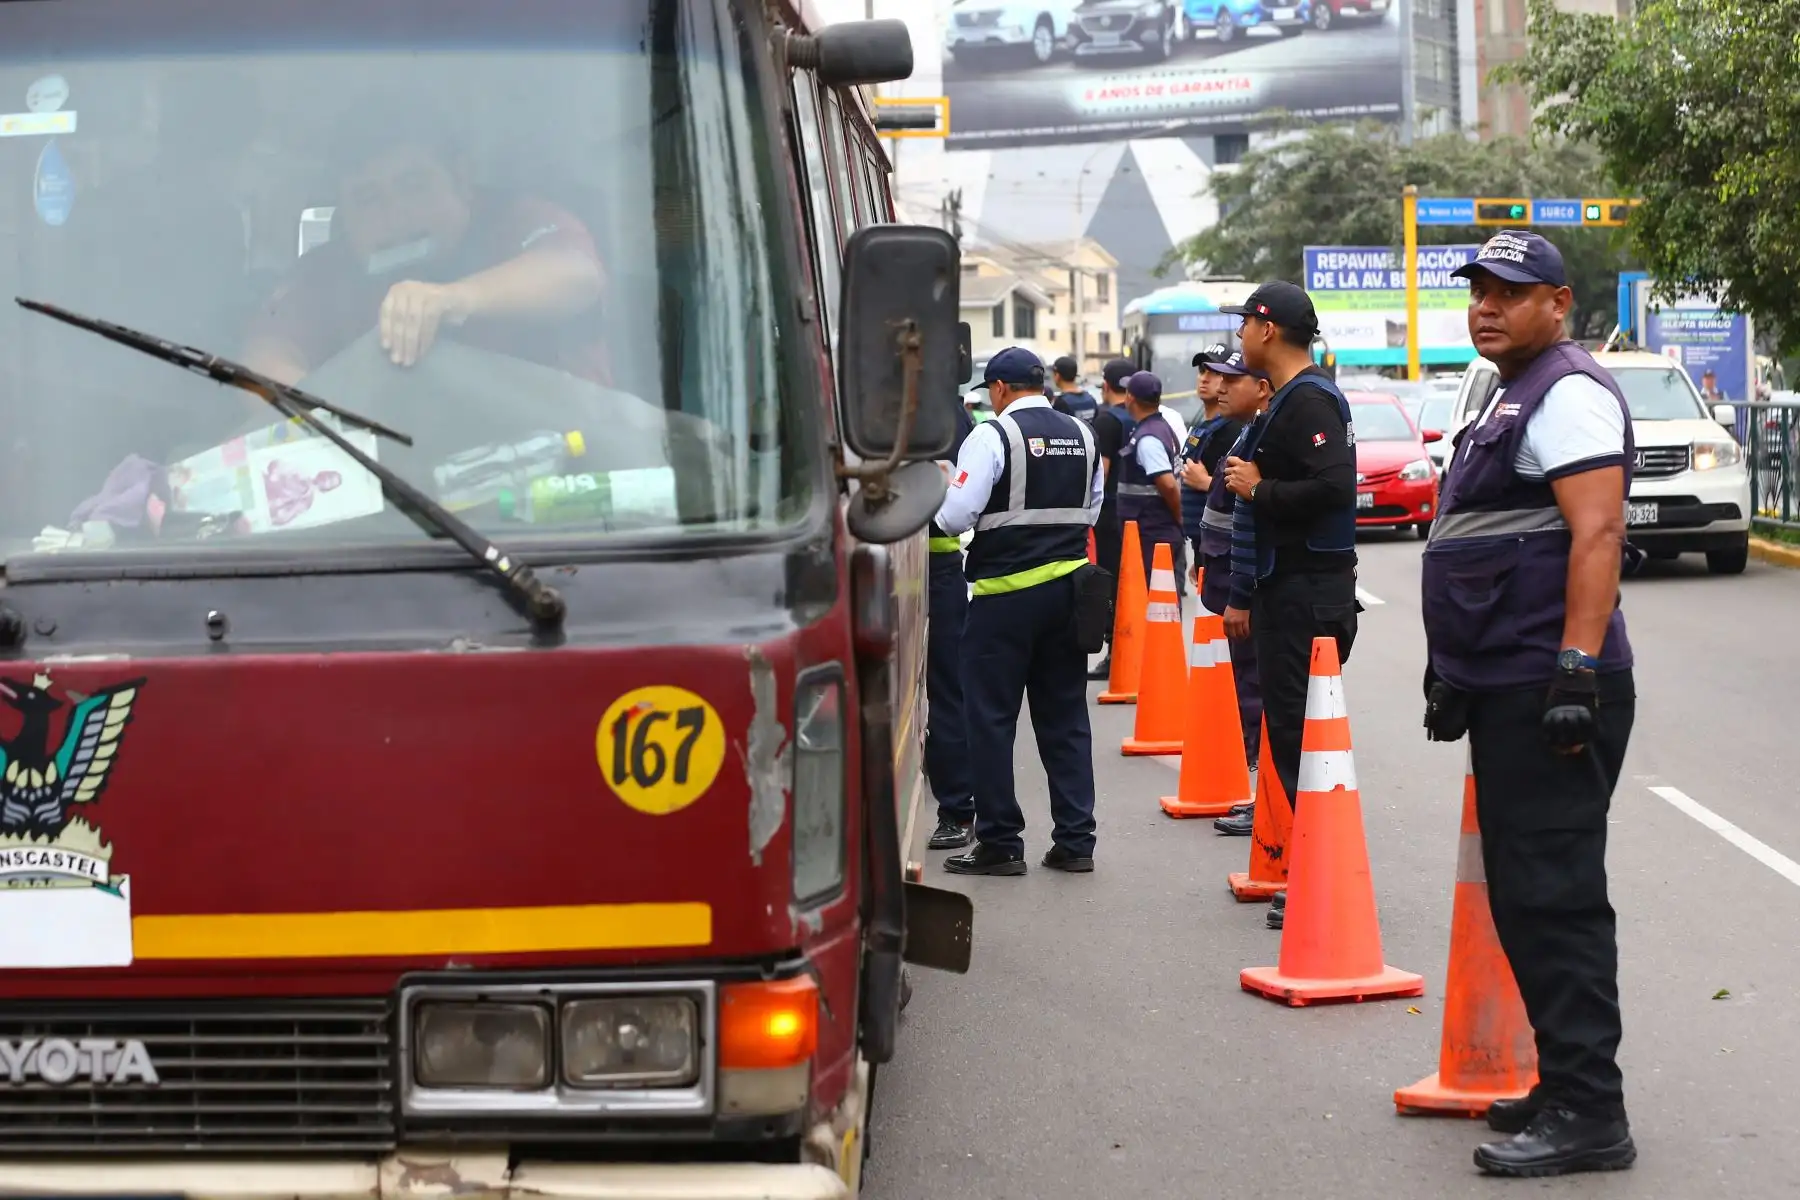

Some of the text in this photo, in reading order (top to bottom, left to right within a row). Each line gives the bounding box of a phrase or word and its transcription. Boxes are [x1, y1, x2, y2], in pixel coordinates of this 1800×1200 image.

[1145, 84, 1164, 96] DE
[1540, 206, 1574, 219] SURCO
[1313, 271, 1335, 289] DE
[1338, 271, 1360, 289] LA
[1362, 271, 1386, 289] AV.
[1046, 447, 1066, 456] SANTIAGO
[611, 705, 705, 789] 167
[0, 1038, 160, 1084] YOTA
